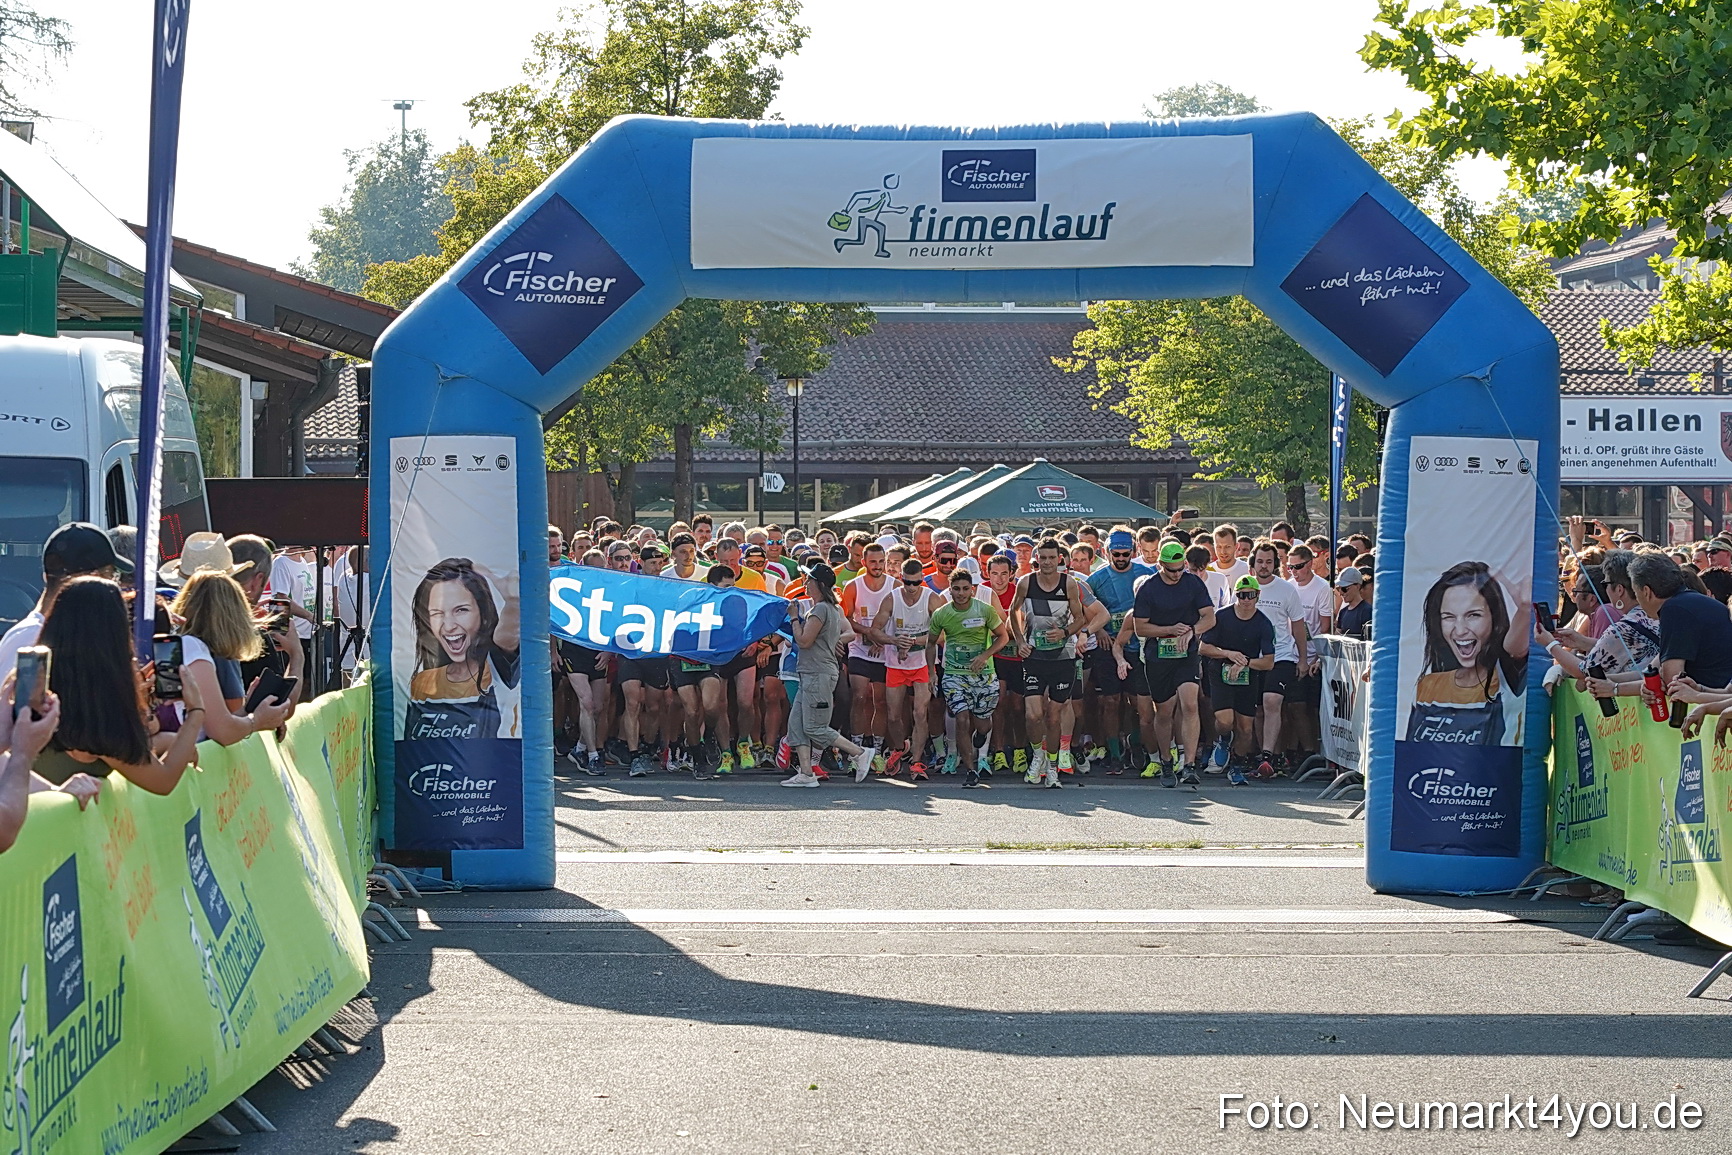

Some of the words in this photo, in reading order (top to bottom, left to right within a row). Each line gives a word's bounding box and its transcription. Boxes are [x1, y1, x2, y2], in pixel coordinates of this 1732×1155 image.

[962, 169, 1031, 182] Fischer
[909, 202, 1117, 241] firmenlauf
[909, 243, 994, 257] neumarkt
[505, 270, 617, 293] Fischer
[1321, 272, 1349, 289] und
[1353, 267, 1382, 283] das
[1385, 264, 1445, 282] Lächeln
[514, 293, 606, 305] AUTOMOBILE
[1360, 285, 1402, 307] fährt
[1406, 281, 1441, 296] mit!
[1588, 408, 1702, 432] Hallen
[1583, 445, 1592, 455] d.
[1596, 445, 1618, 455] OPf.
[1621, 445, 1649, 457] grüßt
[1651, 445, 1671, 455] ihre
[1674, 445, 1704, 455] Gäste
[1560, 458, 1588, 468] einen
[1591, 458, 1657, 470] angenehmen
[1660, 458, 1717, 468] Aufenthalt!
[765, 474, 779, 490] WC
[549, 577, 724, 653] Start
[1684, 767, 1700, 782] Fischer
[423, 777, 497, 791] Fischer
[1423, 781, 1498, 797] Fischer
[429, 792, 491, 800] AUTOMOBILE
[1429, 798, 1491, 806] AUTOMOBILE
[1569, 773, 1608, 823] firmenlauf
[49, 910, 75, 950] Fischer
[33, 955, 126, 1125] firmenlauf
